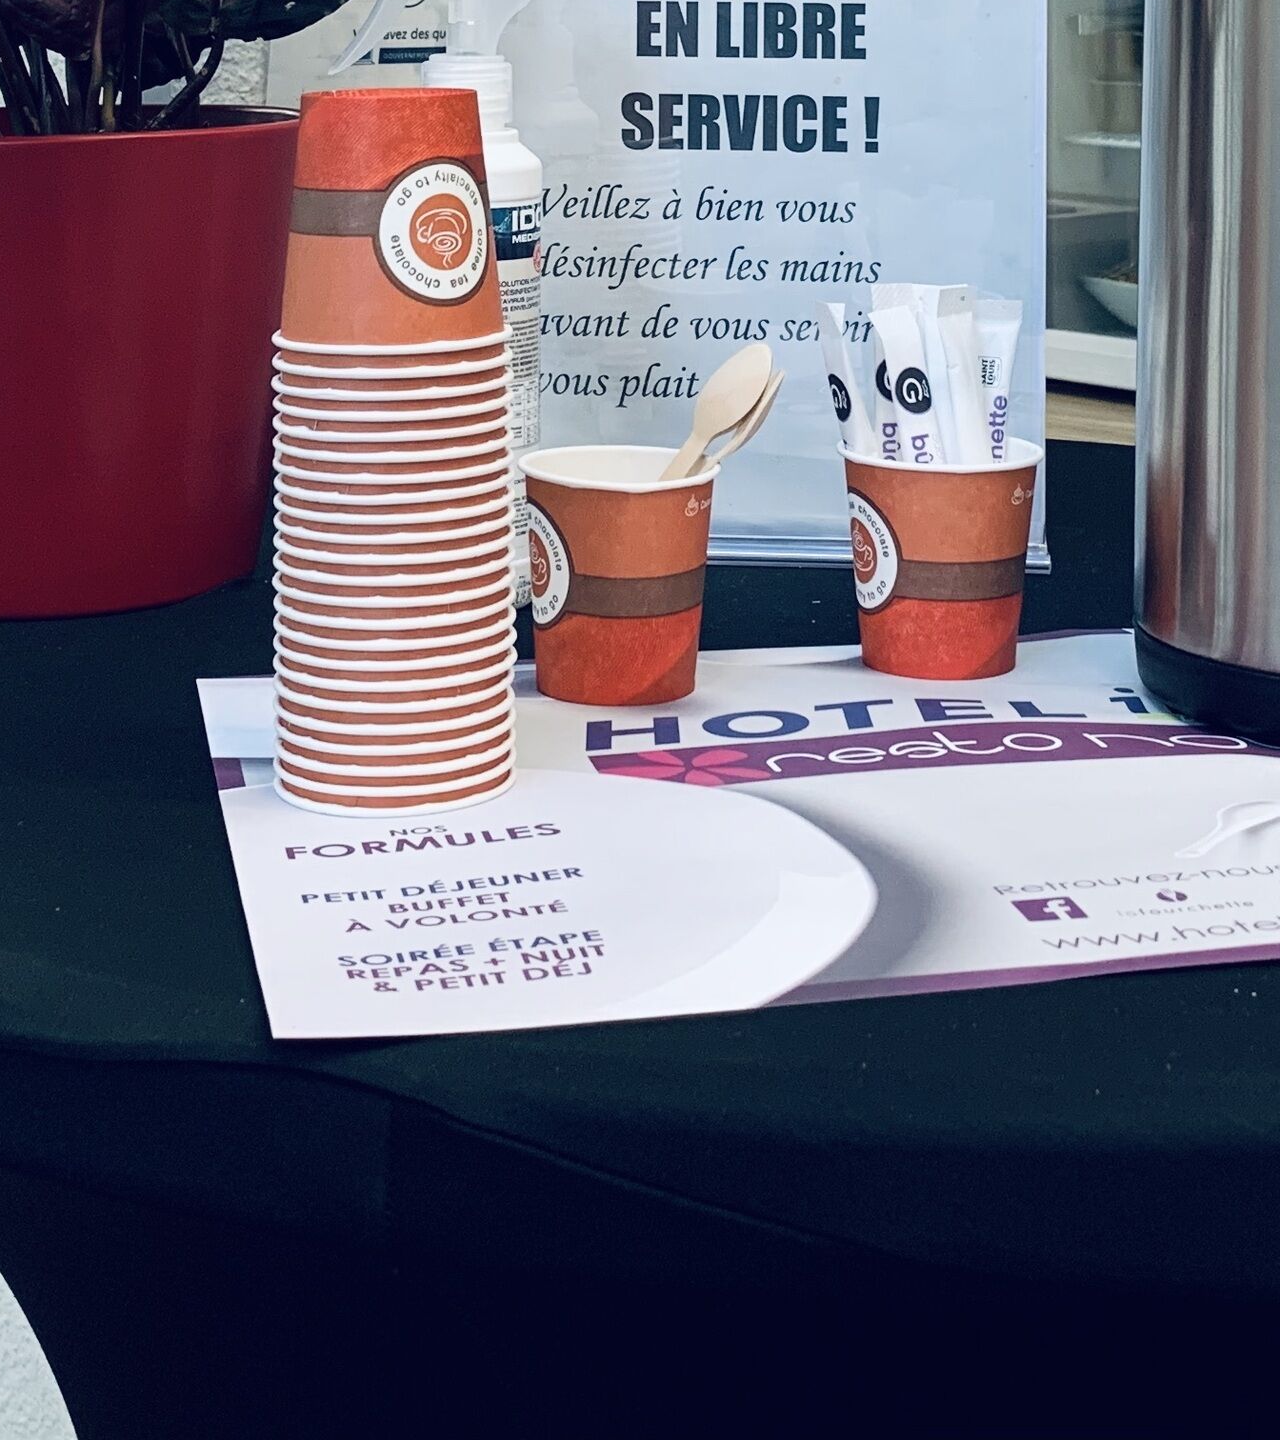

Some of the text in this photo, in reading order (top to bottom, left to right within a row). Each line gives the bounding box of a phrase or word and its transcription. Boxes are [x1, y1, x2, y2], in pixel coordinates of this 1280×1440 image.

[410, 28, 430, 40] des
[636, 1, 866, 60] EN LIBRE
[620, 92, 880, 153] SERVICE !
[397, 169, 478, 206] specialty to go
[542, 184, 856, 223] Veillez à bien vous
[390, 229, 482, 288] coffee tea chocolate
[541, 243, 882, 290] désinfecter les mains
[641, 304, 678, 339] de
[690, 318, 769, 341] vous
[780, 311, 874, 342] serir
[616, 363, 700, 408] plait
[989, 396, 1007, 463] nette
[534, 517, 562, 571] chocolate
[858, 505, 889, 557] chocolate
[877, 581, 886, 595] go
[586, 696, 1086, 751] HOTEL
[765, 731, 1063, 774] resto
[285, 823, 561, 859] FORMULES
[389, 825, 447, 837] NOS
[301, 867, 583, 904] PETIT DÉJEUNER
[389, 893, 511, 913] BUFFET
[345, 900, 569, 933] À VOLONTÉ
[338, 930, 603, 967] SOIRÉE ÉTAPE
[346, 959, 468, 980] REPAS
[523, 945, 606, 965] NUIT
[374, 962, 592, 992] & PETIT DÉJ
